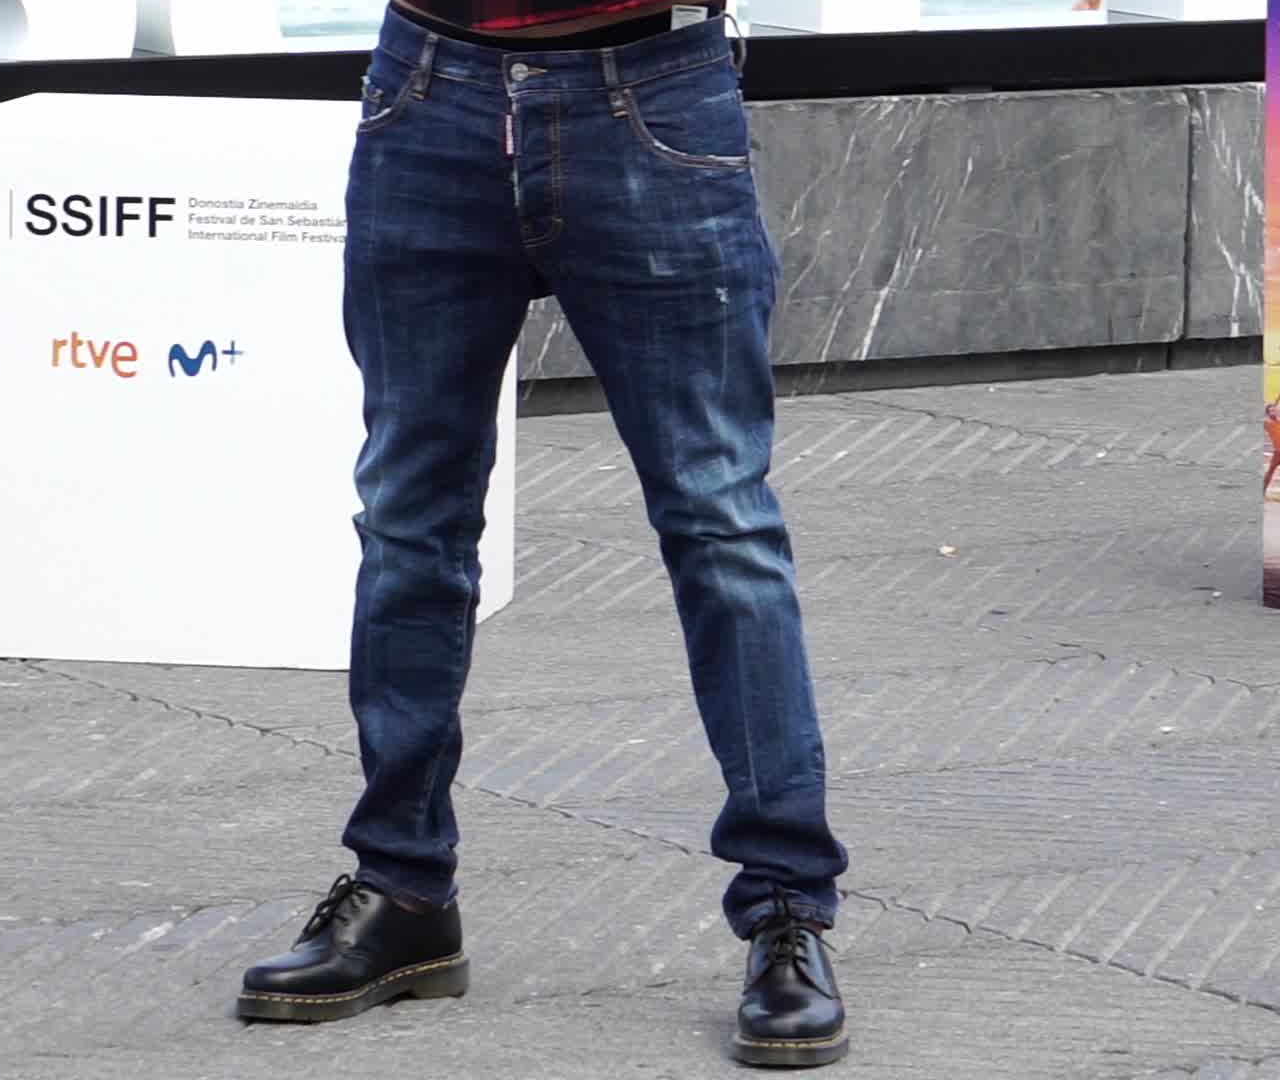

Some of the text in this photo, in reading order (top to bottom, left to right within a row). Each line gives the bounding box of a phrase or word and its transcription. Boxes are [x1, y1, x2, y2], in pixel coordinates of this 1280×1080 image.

[187, 197, 318, 211] Donostia Zinemaldia
[25, 193, 176, 237] SSIFF
[187, 213, 237, 225] Festival
[239, 214, 255, 226] de
[259, 215, 284, 227] San
[188, 229, 348, 244] International Film Festiva
[51, 331, 138, 378] rtve
